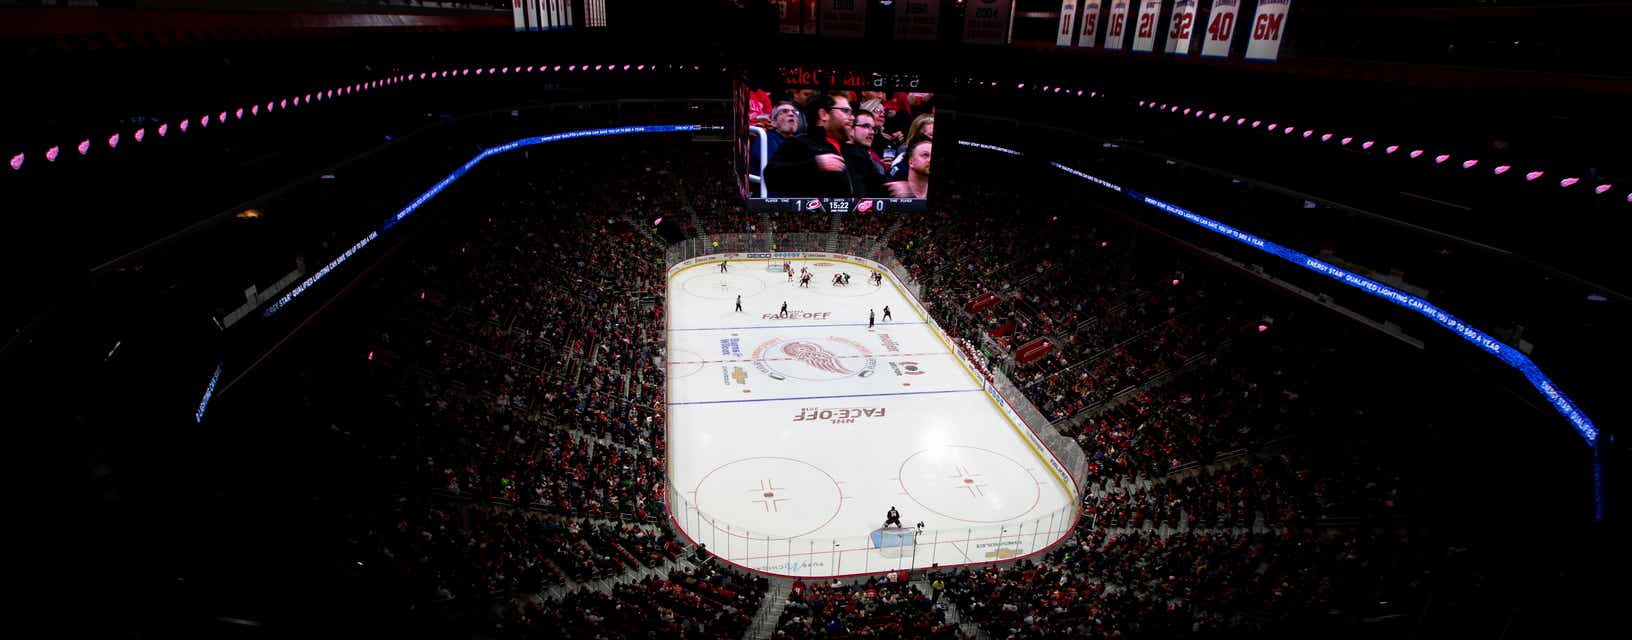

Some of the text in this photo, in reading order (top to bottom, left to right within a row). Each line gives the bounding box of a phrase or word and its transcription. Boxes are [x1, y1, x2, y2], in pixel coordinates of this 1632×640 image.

[1062, 14, 1071, 34] 11
[1083, 14, 1096, 36] 15
[1110, 14, 1124, 36] 16
[1138, 13, 1155, 38] 21
[1170, 12, 1192, 39] 32
[1208, 12, 1234, 42] 40
[796, 200, 802, 212] 1
[876, 200, 884, 212] 0
[1307, 260, 1328, 272] ENERGY
[1346, 274, 1378, 292] QUALIFIED
[1378, 286, 1408, 304] LIGHTING
[1408, 298, 1424, 310] CAN
[1424, 304, 1436, 316] SAVE
[1436, 312, 1448, 324] YOU
[1448, 318, 1456, 328] UP
[1456, 322, 1464, 332] TO
[793, 408, 886, 422] FACE-OFF
